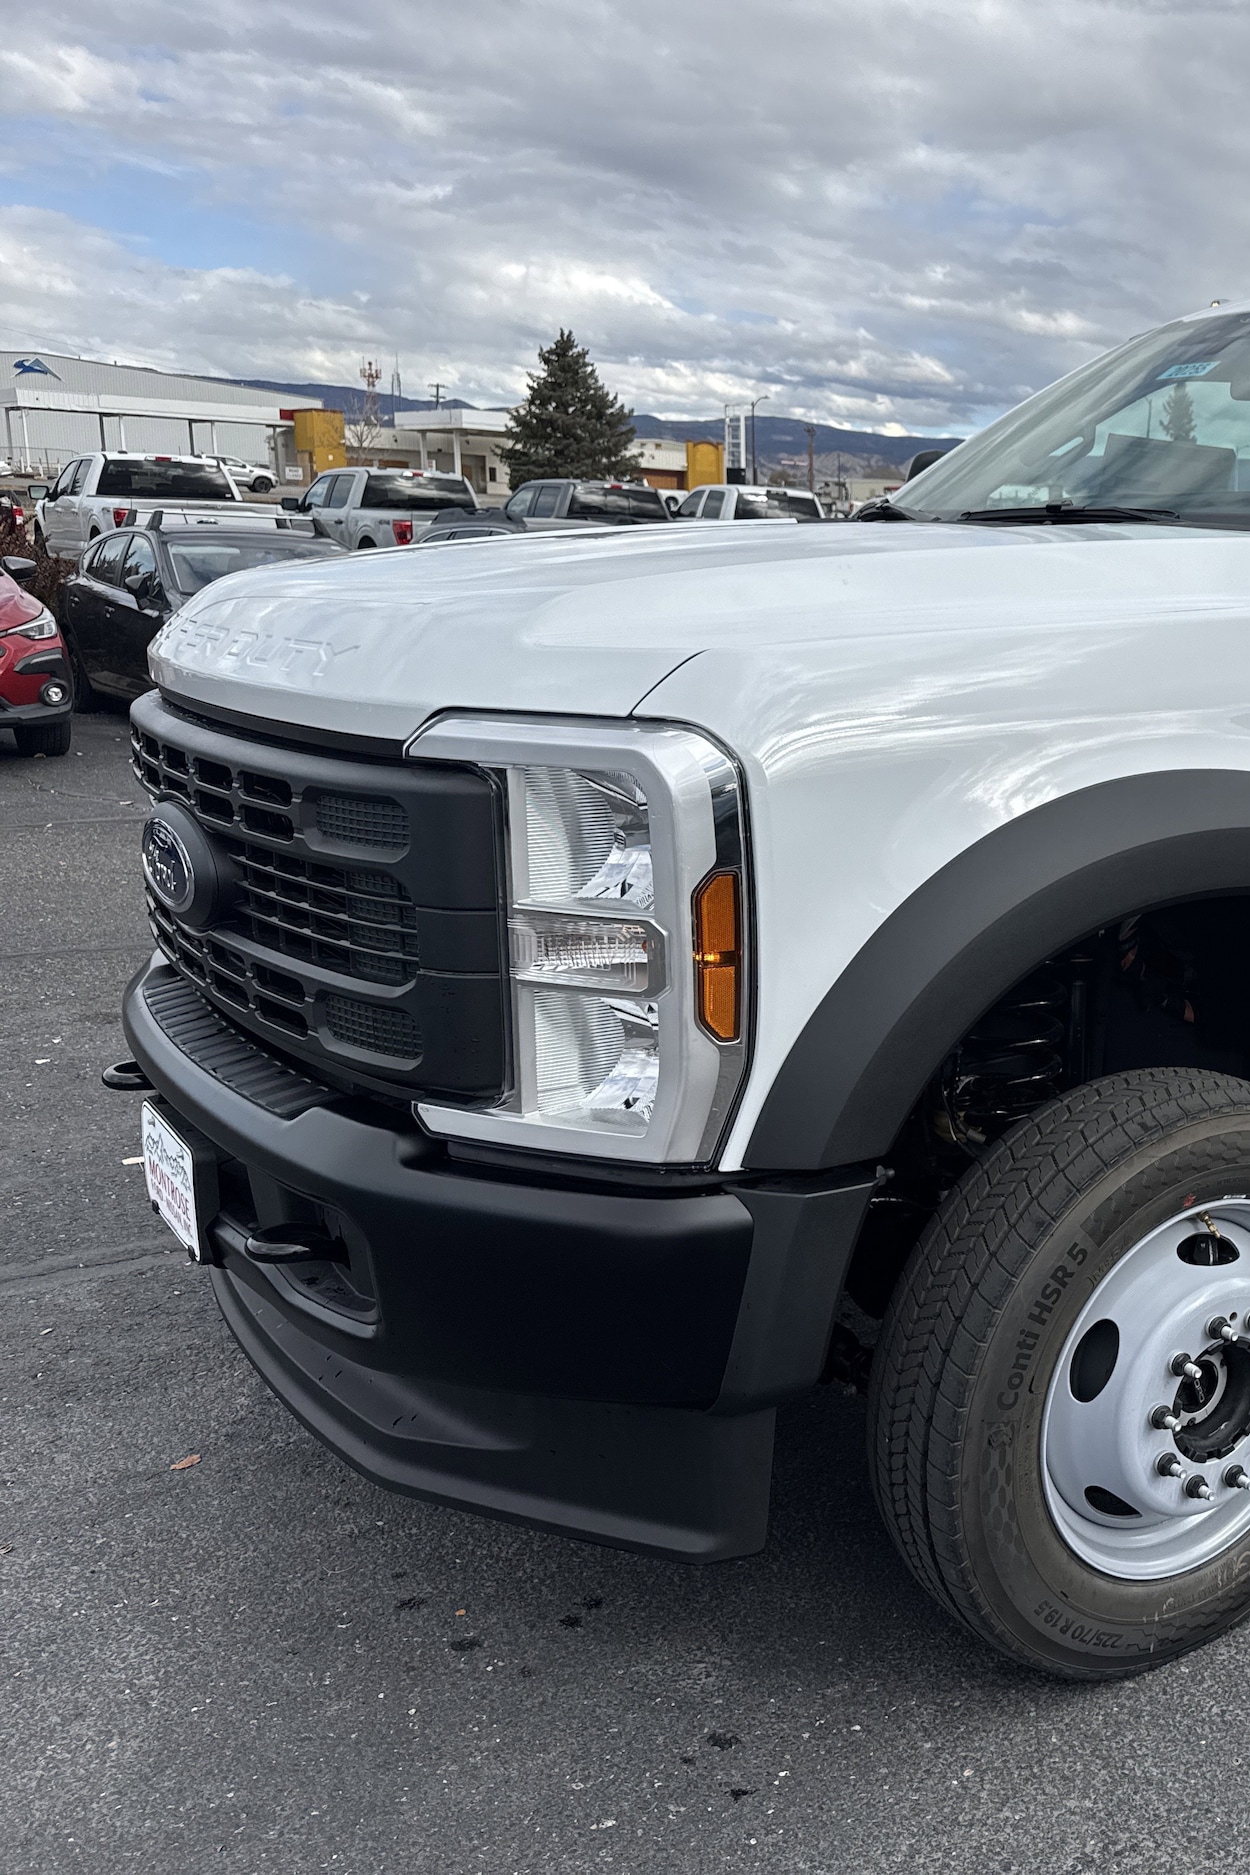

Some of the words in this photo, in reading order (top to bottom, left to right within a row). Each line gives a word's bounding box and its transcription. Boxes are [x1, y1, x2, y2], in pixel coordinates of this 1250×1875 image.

[219, 628, 361, 677] DUTY
[149, 1155, 191, 1222] MONTROSE
[997, 1328, 1041, 1410] Conti
[1027, 1264, 1075, 1326] HSR
[1066, 1241, 1088, 1266] 5
[1070, 1625, 1125, 1650] 225/70
